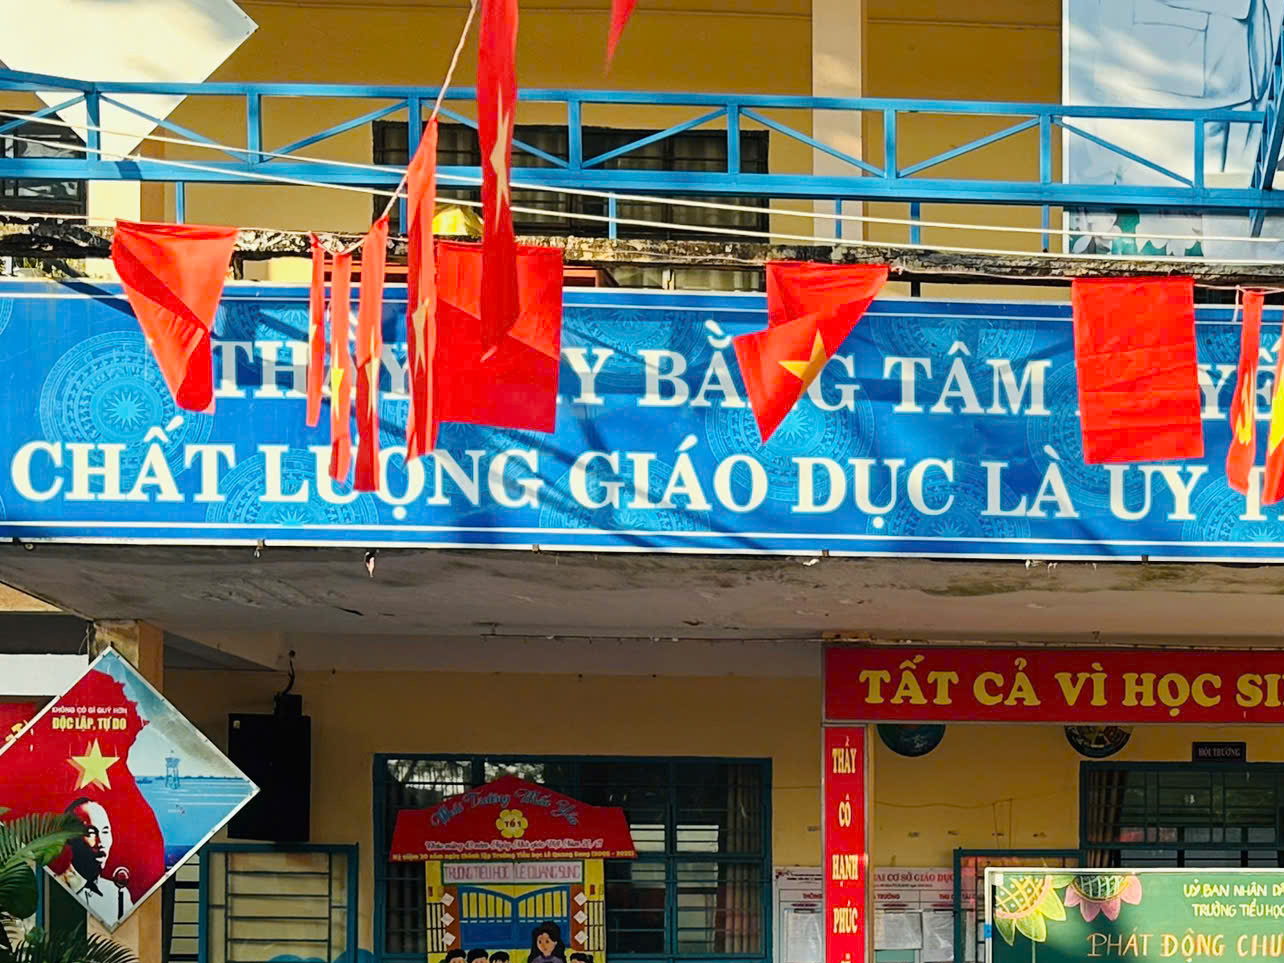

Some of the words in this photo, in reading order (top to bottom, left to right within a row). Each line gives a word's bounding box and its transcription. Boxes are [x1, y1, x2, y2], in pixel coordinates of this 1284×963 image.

[637, 319, 860, 412] BẰG
[883, 340, 1053, 416] TÂM
[11, 415, 236, 502] CHẤT
[569, 435, 712, 512] GIÁO
[791, 457, 955, 529] DỤC
[986, 446, 1080, 519] LÀ
[1103, 464, 1207, 521] UY
[858, 654, 959, 705] TẤT
[973, 657, 1041, 706] CẢ
[1054, 662, 1108, 707] VÌ
[1122, 672, 1222, 717] HỌC
[52, 715, 74, 732] ĐỘC
[75, 715, 96, 732] LẬP,
[97, 715, 112, 732] TỰ
[112, 717, 127, 730] DO
[76, 705, 87, 714] CÓ
[87, 705, 96, 714] GÌ
[97, 705, 112, 714] QUÝ
[832, 736, 857, 774] THẦY
[838, 794, 852, 828] CÔ
[832, 855, 858, 887] HẠNH
[1202, 884, 1229, 898] BAN
[1234, 881, 1267, 897] NHÂN
[833, 901, 858, 934] PHÚC
[1192, 901, 1237, 917] TRƯỜNG
[1239, 898, 1265, 917] TIỂU
[1086, 926, 1153, 958] PHÁT
[1159, 927, 1226, 963] ĐỘNG
